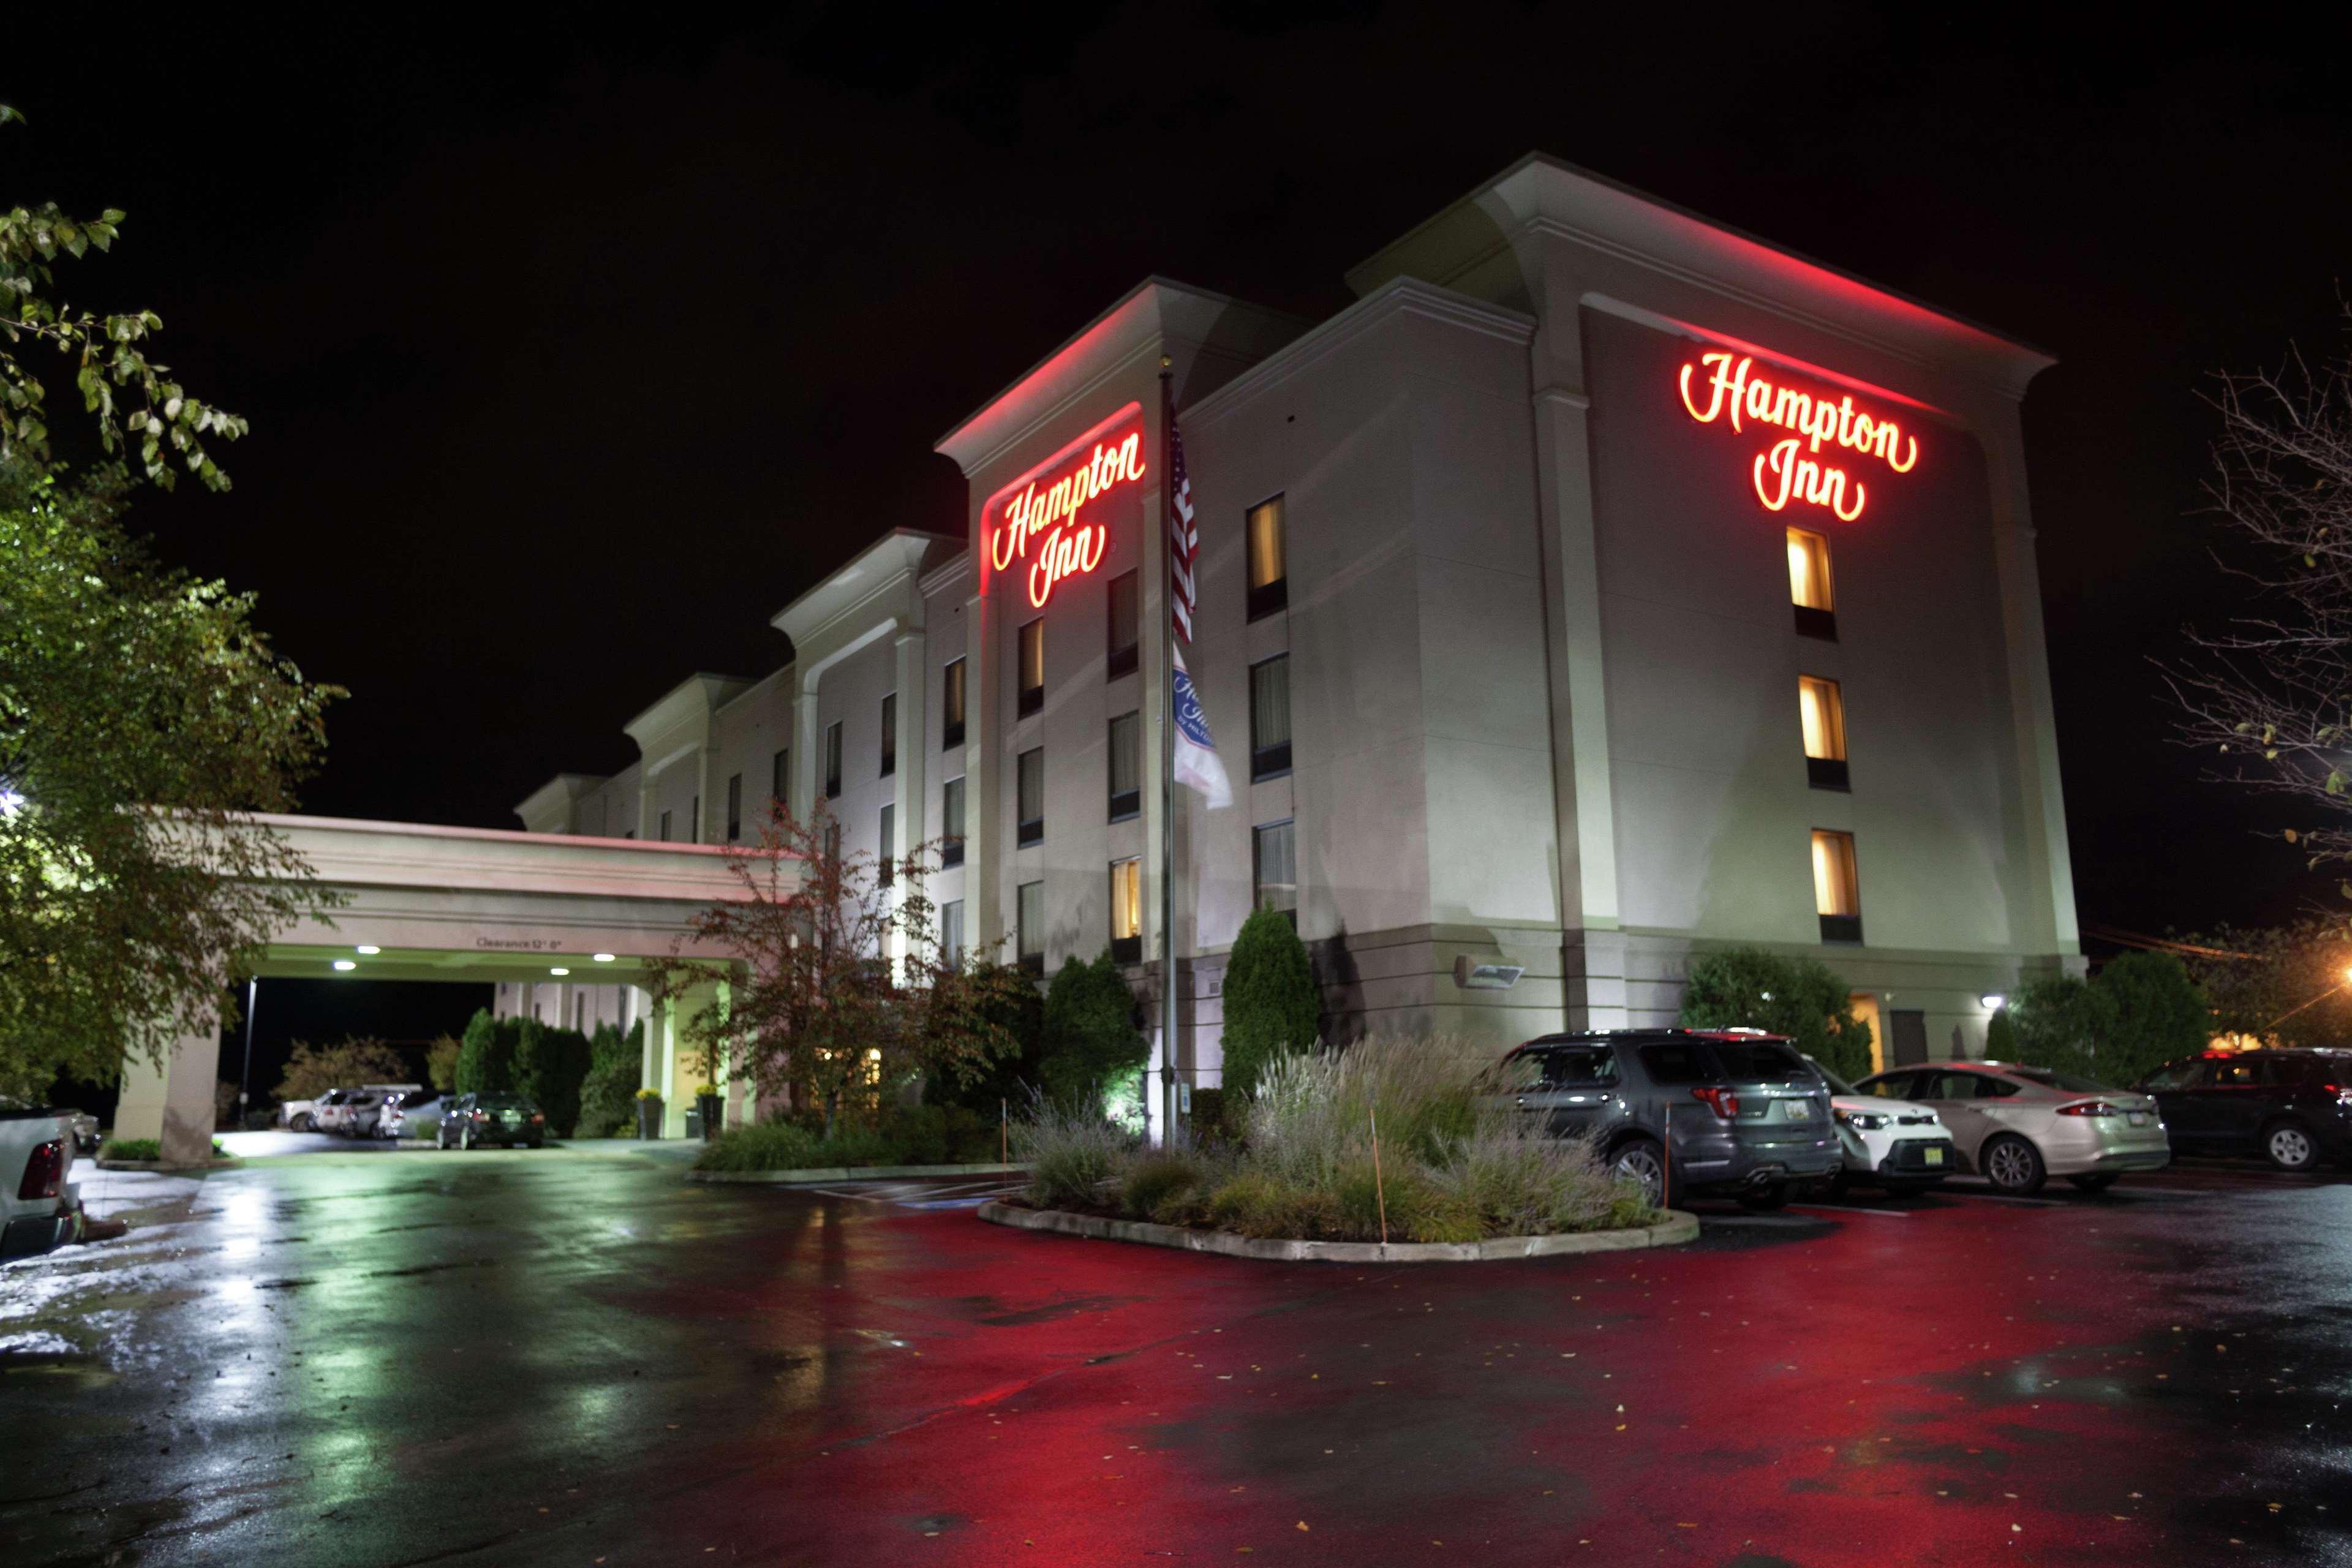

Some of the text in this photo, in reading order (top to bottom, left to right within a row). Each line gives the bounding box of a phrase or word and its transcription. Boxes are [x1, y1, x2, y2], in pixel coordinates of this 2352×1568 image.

[1679, 352, 1918, 473] Hampton
[992, 432, 1146, 571] Hampton
[1753, 439, 1866, 522] Inn
[1029, 525, 1106, 608] Inn
